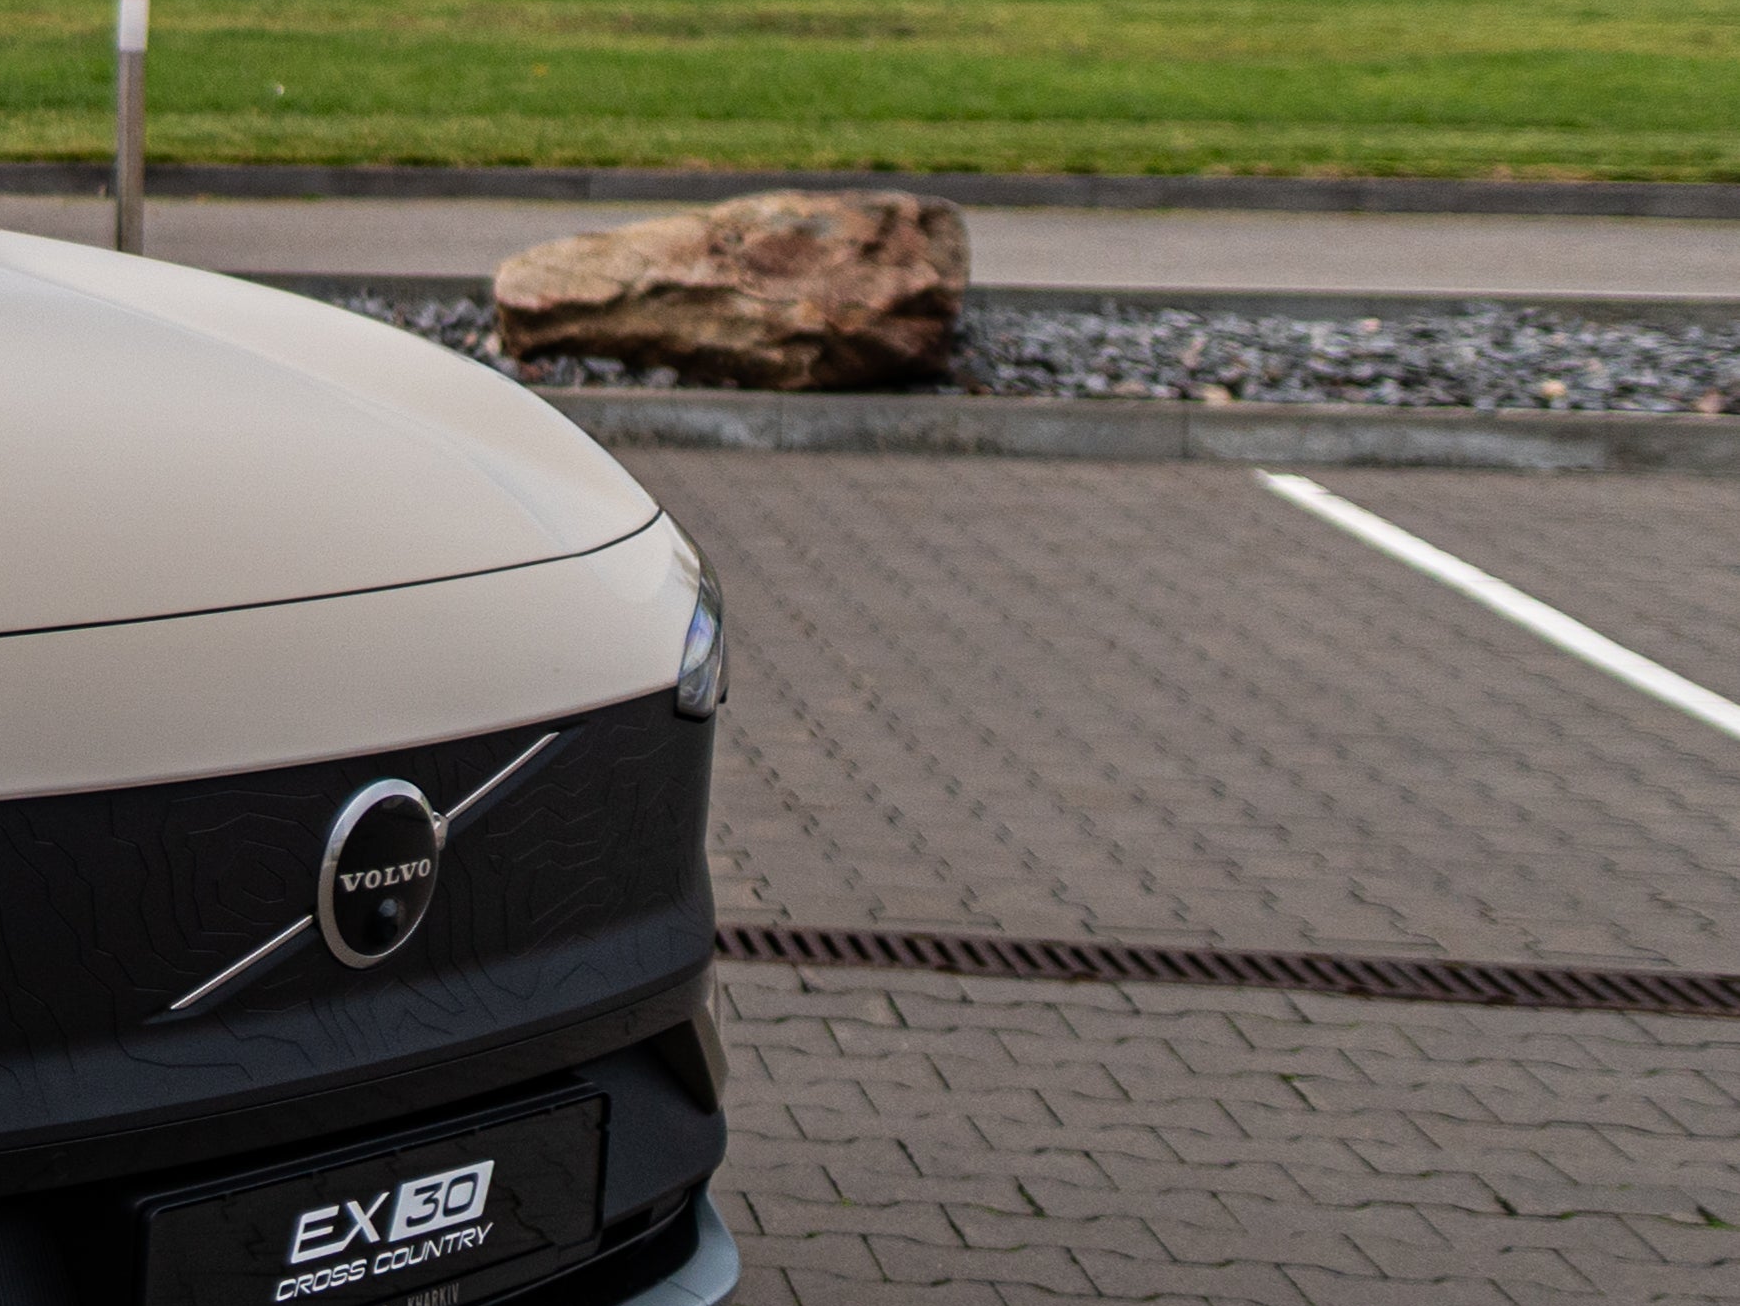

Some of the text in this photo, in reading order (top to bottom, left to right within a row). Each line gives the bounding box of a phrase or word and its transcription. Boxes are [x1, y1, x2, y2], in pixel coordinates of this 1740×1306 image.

[339, 858, 432, 892] VOLVO
[274, 1222, 494, 1302] CROSS COUNTRY
